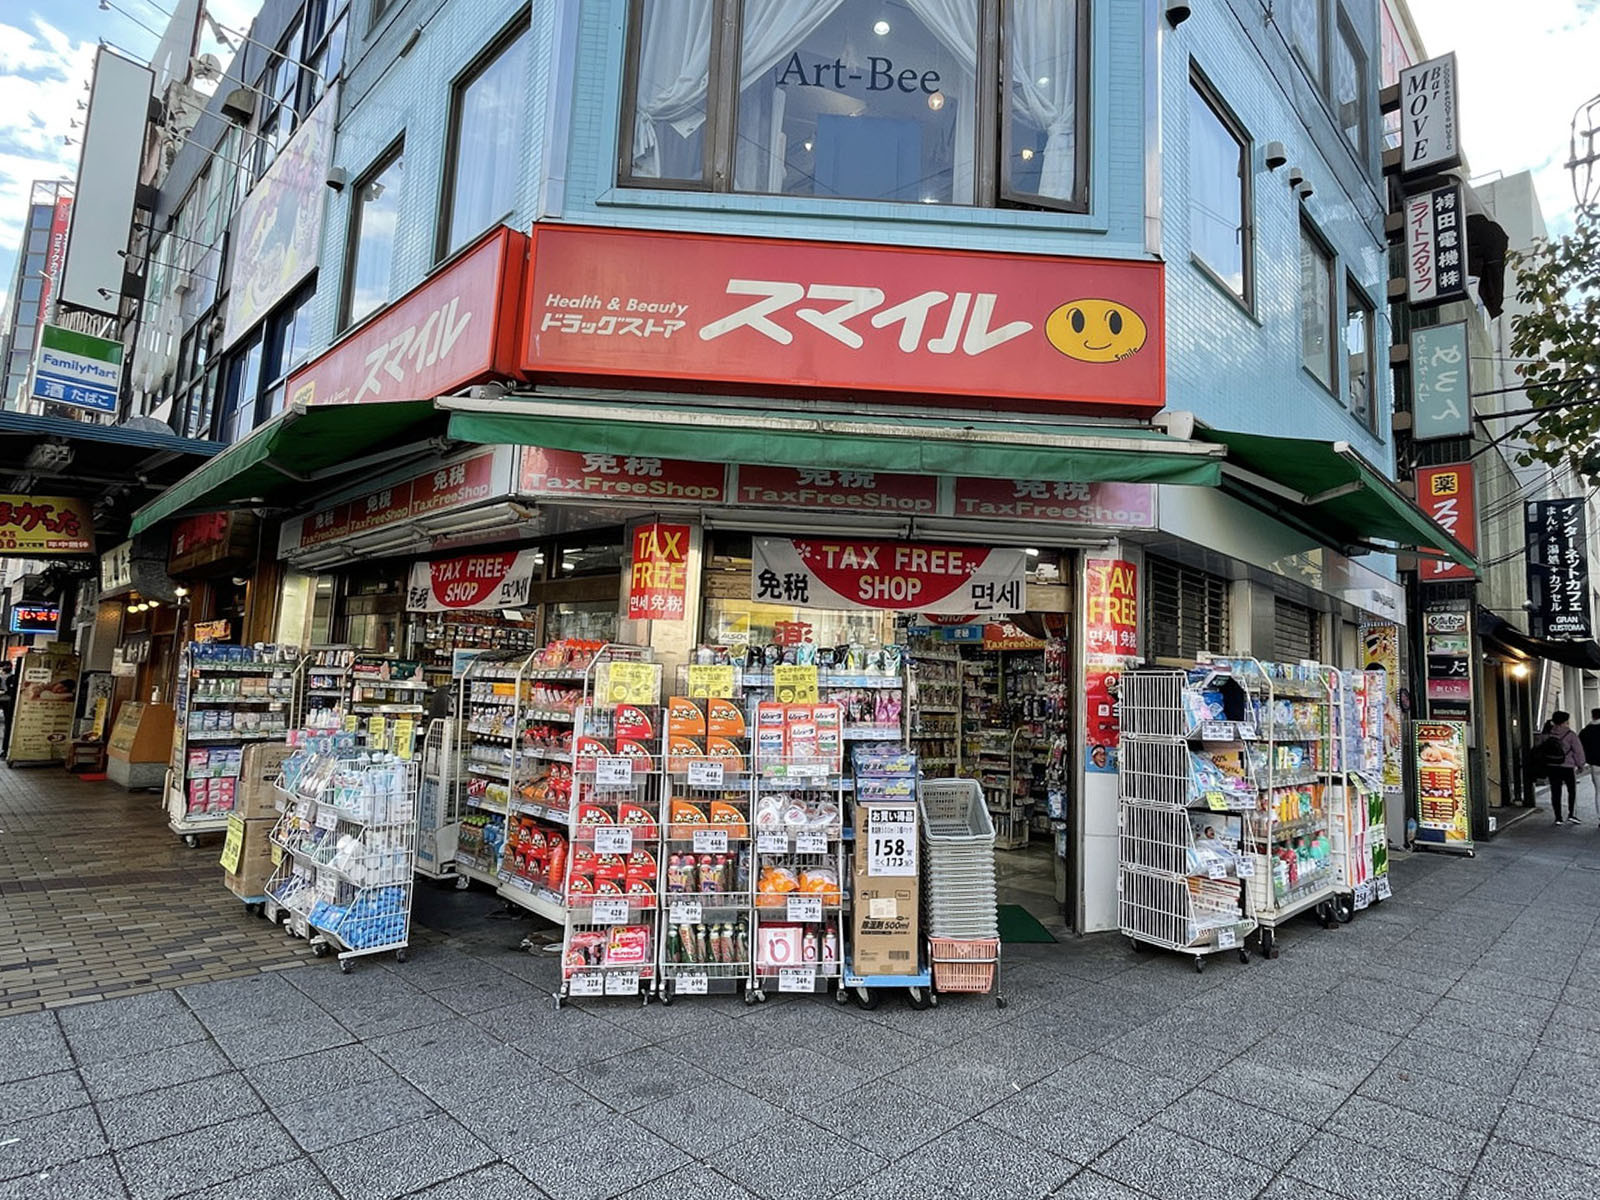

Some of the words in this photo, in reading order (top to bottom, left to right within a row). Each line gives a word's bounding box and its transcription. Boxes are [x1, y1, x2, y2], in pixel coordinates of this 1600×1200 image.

[778, 52, 940, 94] Art-Bee
[1430, 66, 1441, 100] Bar
[1407, 69, 1430, 161] MOVE
[1410, 201, 1432, 293] ライトスタッフ
[545, 293, 601, 311] Health
[607, 296, 620, 311] &
[626, 298, 688, 316] Beauty
[699, 279, 1033, 356] スマイル
[541, 312, 686, 338] ドラッグストア
[43, 354, 117, 379] FamilyMart
[44, 381, 65, 399] 酒
[71, 388, 109, 406] たばこ
[433, 464, 465, 492] 免税
[582, 454, 663, 476] 免税
[528, 473, 719, 499] TaxFreeShop
[1434, 475, 1456, 493] 薬
[413, 483, 490, 512] TaxFreeShop
[743, 487, 932, 511] TaxFreeShop
[961, 498, 1146, 523] TaxFreeShop
[351, 508, 409, 531] TaxFreeShop
[638, 531, 682, 559] TAX
[1562, 504, 1583, 612] インターネットカフェ
[438, 561, 463, 582] TAX
[467, 558, 503, 578] FREE
[822, 545, 880, 570] TAX
[896, 547, 963, 575] FREE
[632, 561, 686, 590] FREE
[757, 568, 809, 603] 免税
[858, 576, 922, 601] SHOP
[1095, 566, 1134, 597] TAX
[445, 582, 479, 602] SHOP
[650, 595, 683, 612] 免税
[971, 580, 1020, 610] 면세
[1089, 596, 1136, 626] FREE
[1556, 616, 1578, 624] GRAN
[872, 811, 913, 822] お買い得品
[875, 839, 905, 856] 158
[886, 857, 904, 866] 173
